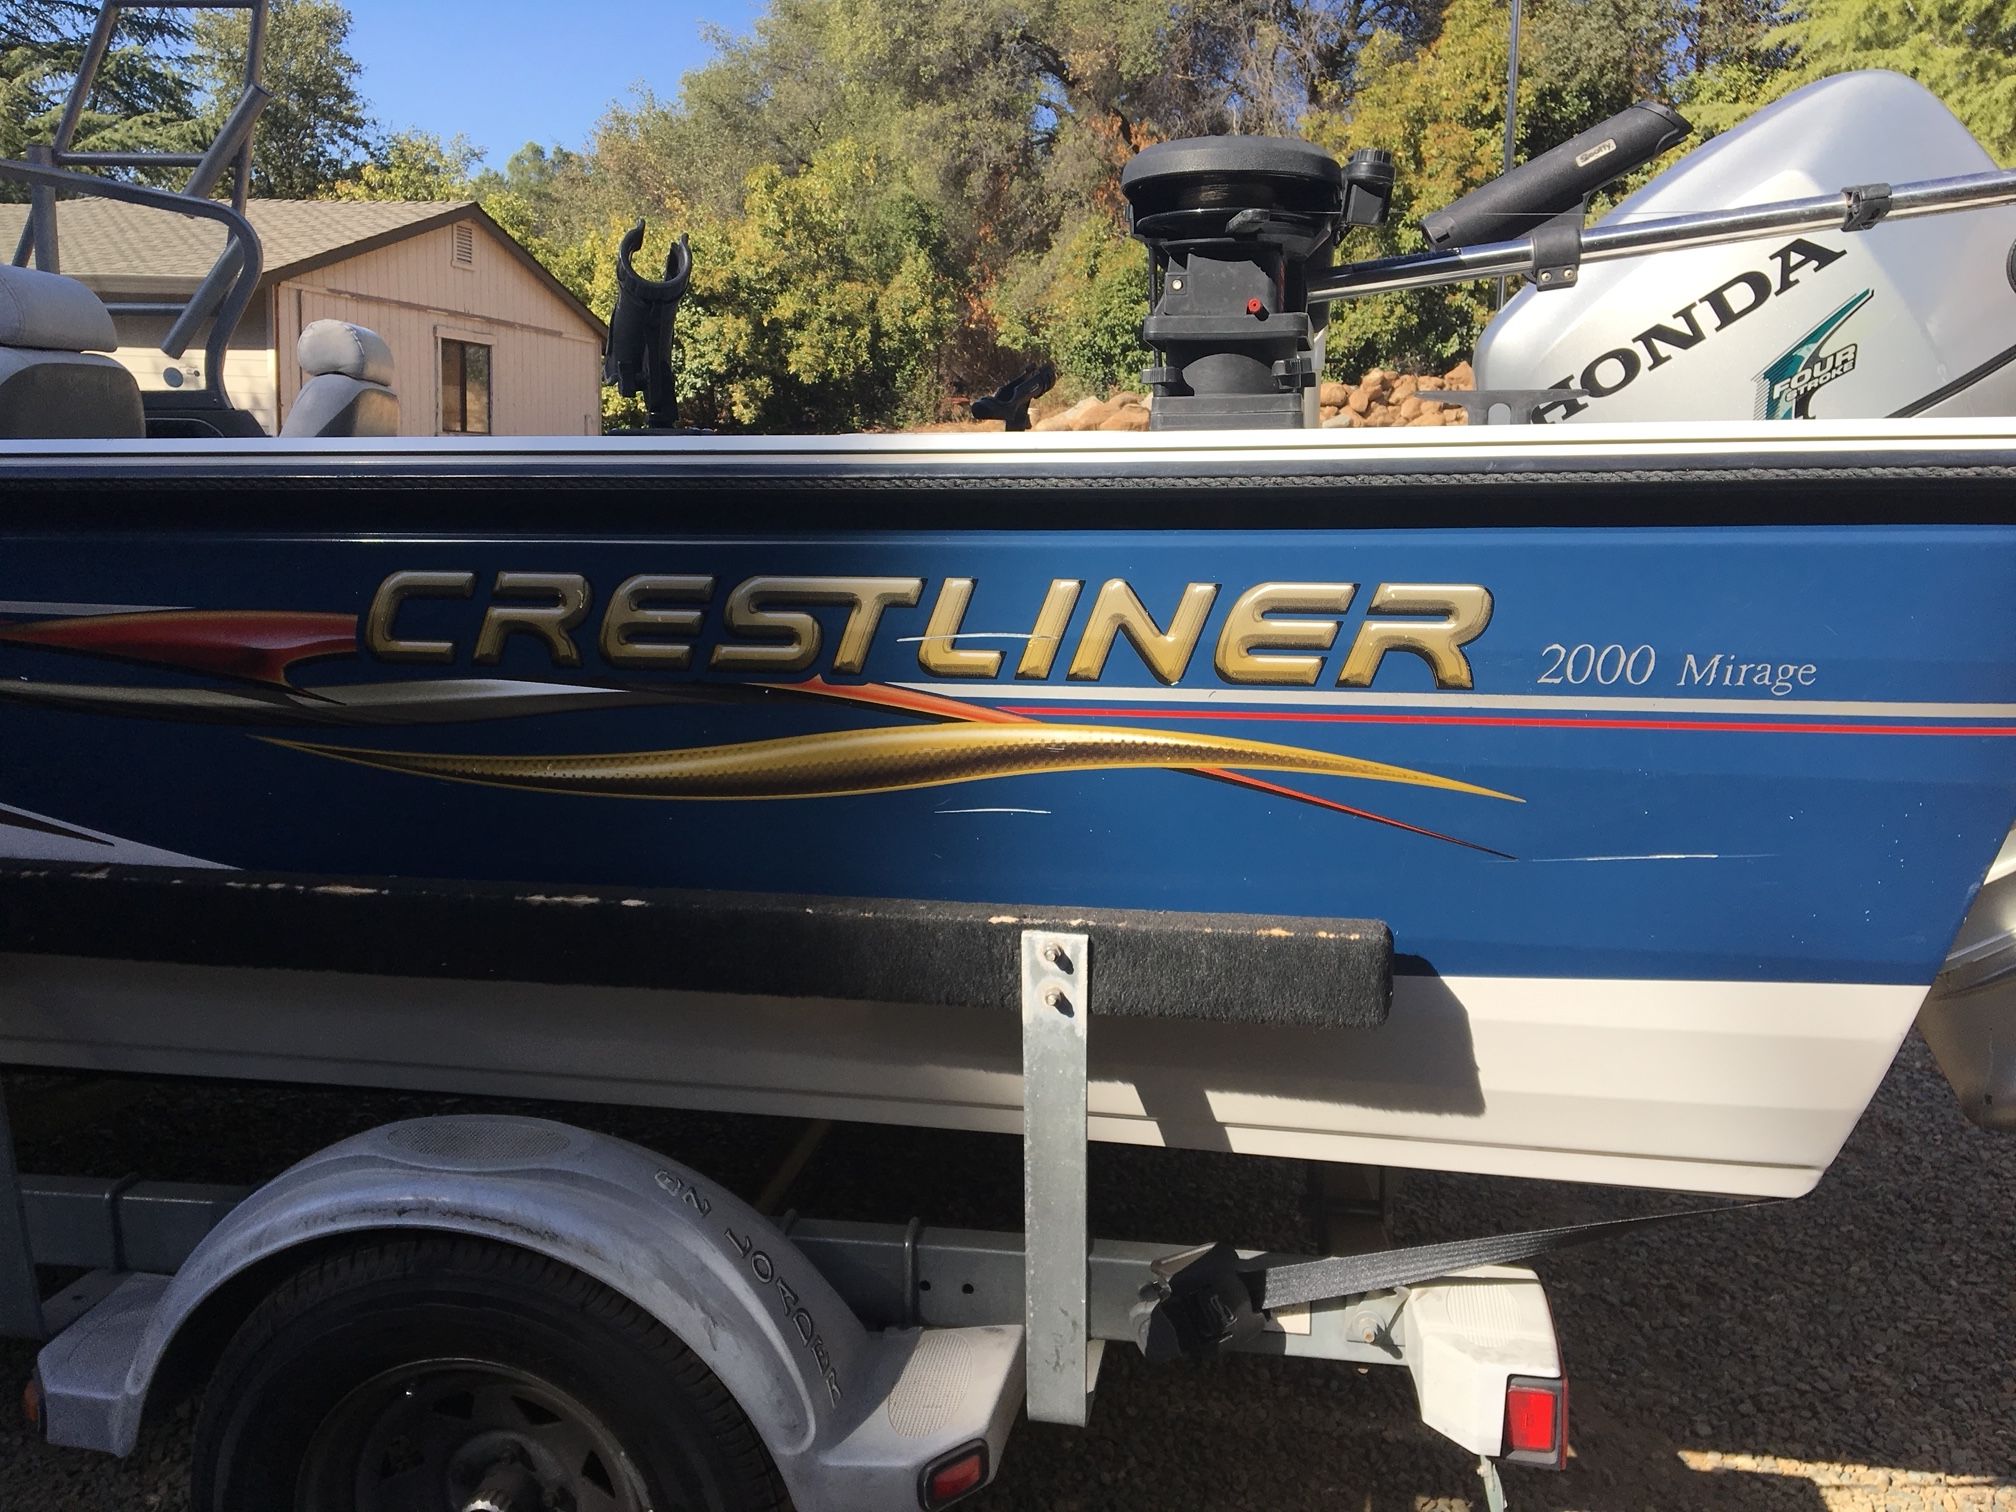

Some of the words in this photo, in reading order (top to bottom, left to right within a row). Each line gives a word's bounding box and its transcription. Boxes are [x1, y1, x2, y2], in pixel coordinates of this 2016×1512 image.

[1773, 345, 1857, 400] FOUR
[1784, 361, 1855, 401] STROKE
[365, 570, 1494, 690] CRESTLINER
[1536, 643, 1656, 685] 2000
[1676, 653, 1818, 696] Mirage
[725, 1228, 843, 1408] LOADER
